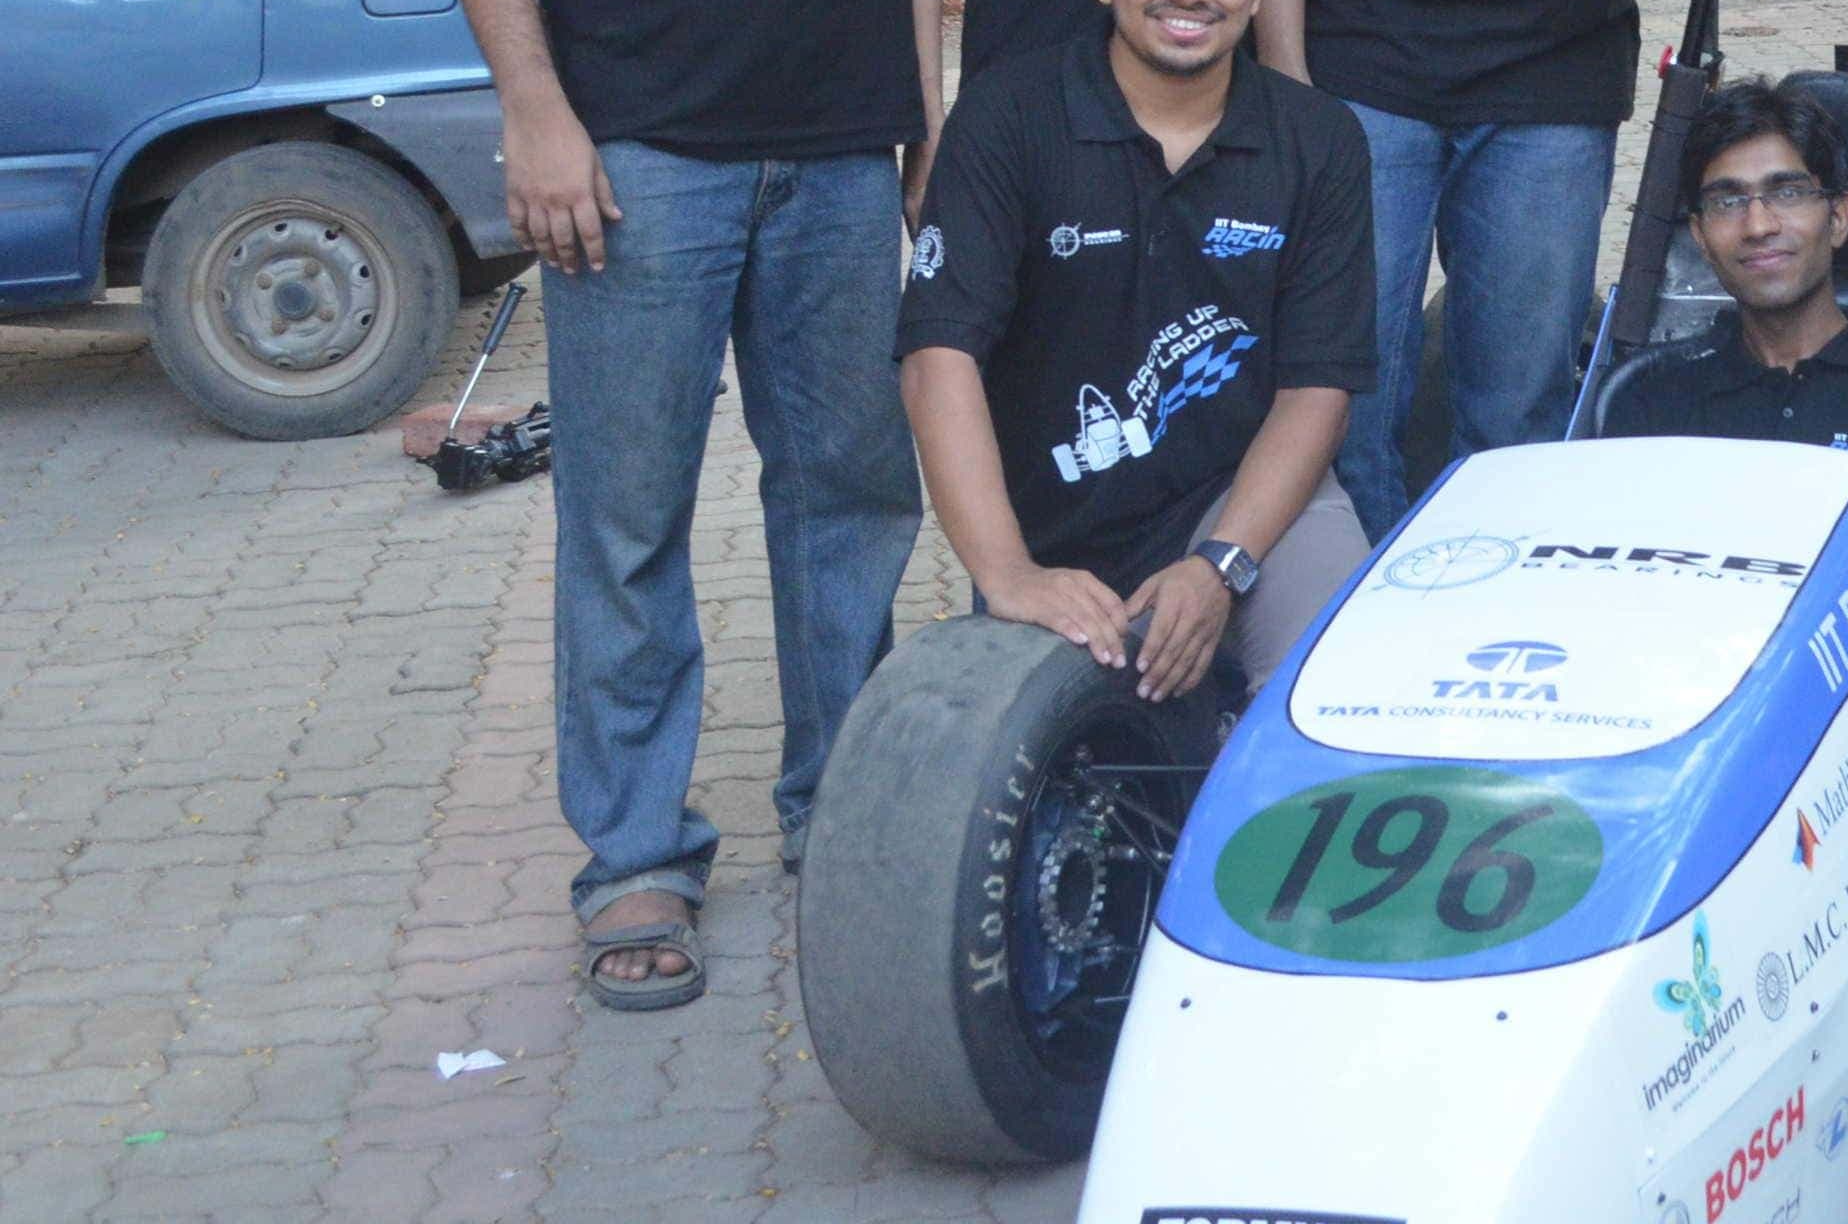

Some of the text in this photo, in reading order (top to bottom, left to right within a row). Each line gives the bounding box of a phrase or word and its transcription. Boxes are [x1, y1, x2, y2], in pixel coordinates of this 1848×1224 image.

[1127, 304, 1219, 402] RACING UP
[1133, 317, 1248, 421] THE LADDER
[1520, 562, 1800, 588] BEARINGS
[1528, 545, 1806, 576] NRB
[1317, 706, 1653, 730] TATA CONSULTANCY SERVICES
[1431, 680, 1559, 702] TATA
[1264, 791, 1556, 933] 196
[1642, 997, 1746, 1110] imaginarium
[1705, 1084, 1805, 1224] BOSCH
